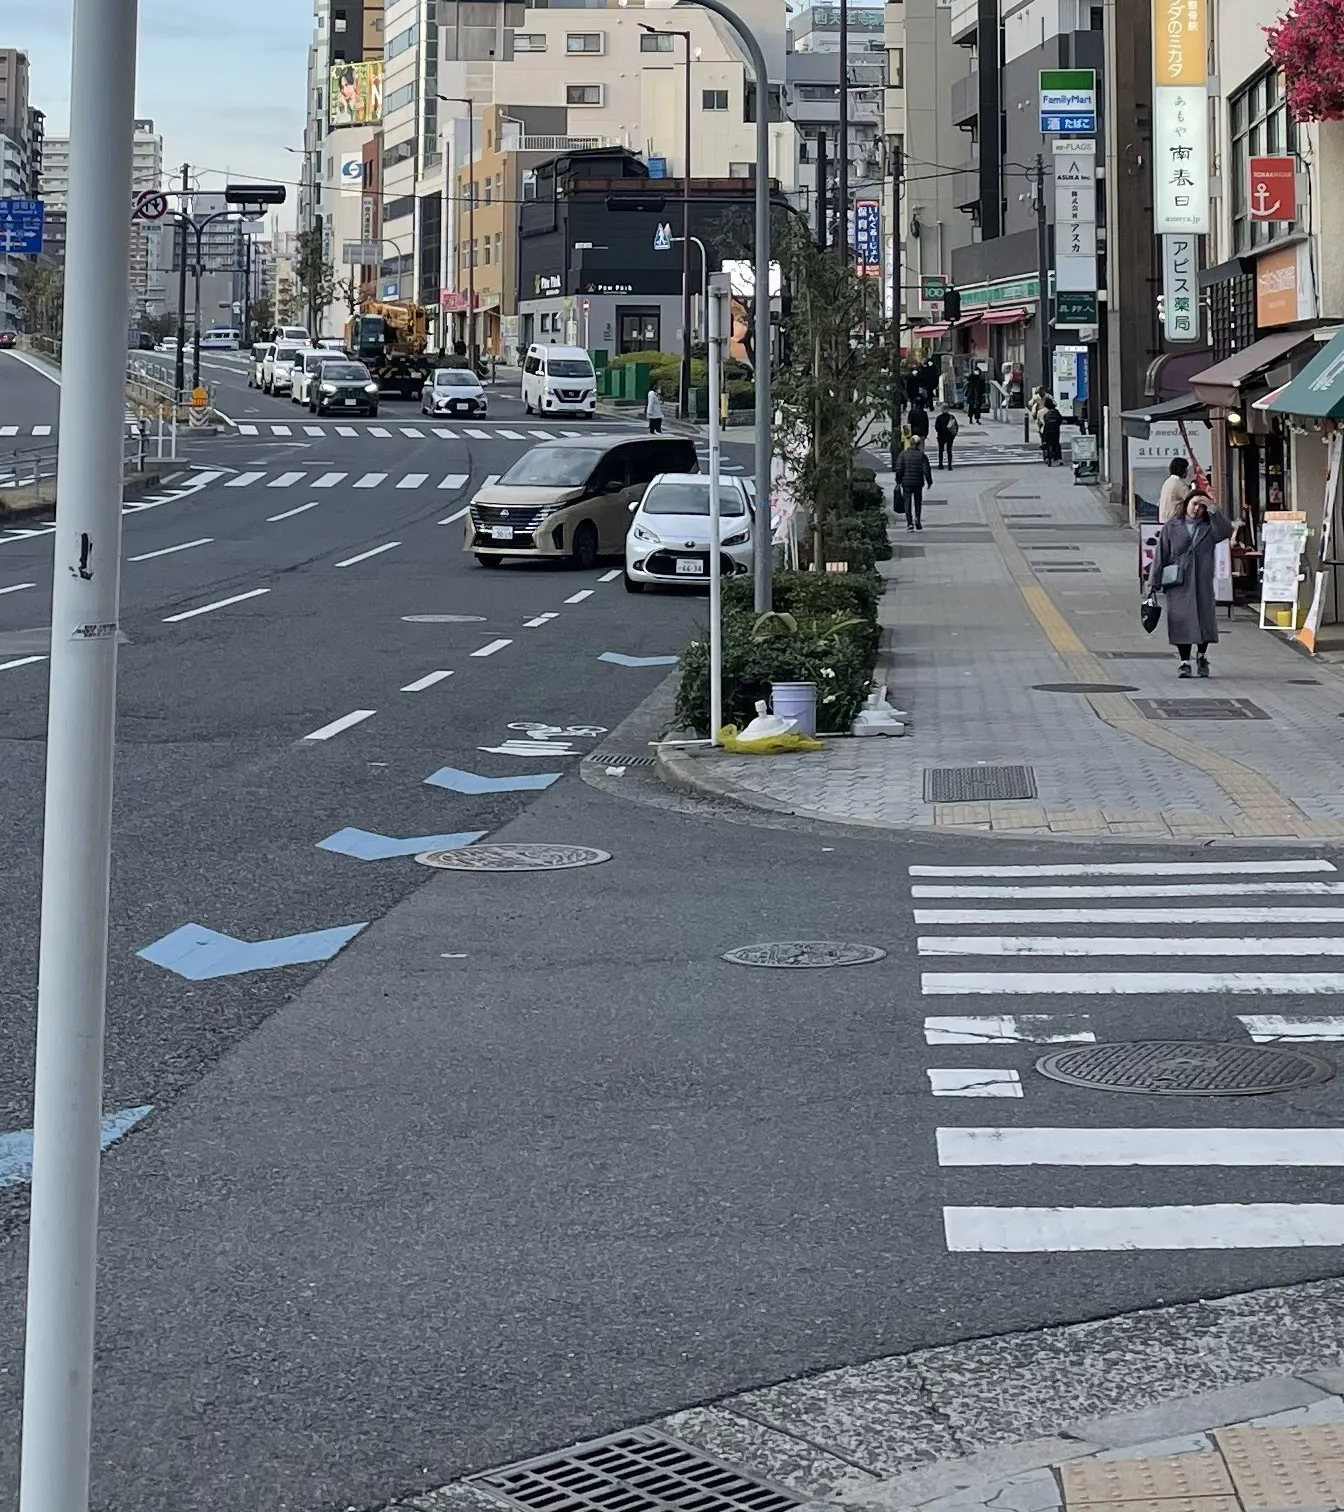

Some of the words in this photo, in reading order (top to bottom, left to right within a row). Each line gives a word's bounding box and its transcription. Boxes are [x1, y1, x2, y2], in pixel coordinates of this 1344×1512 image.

[1042, 94, 1092, 106] FamilyMart
[1064, 118, 1091, 129] たばこ
[1174, 95, 1188, 137] あもや
[1172, 241, 1191, 332] アピス薬局
